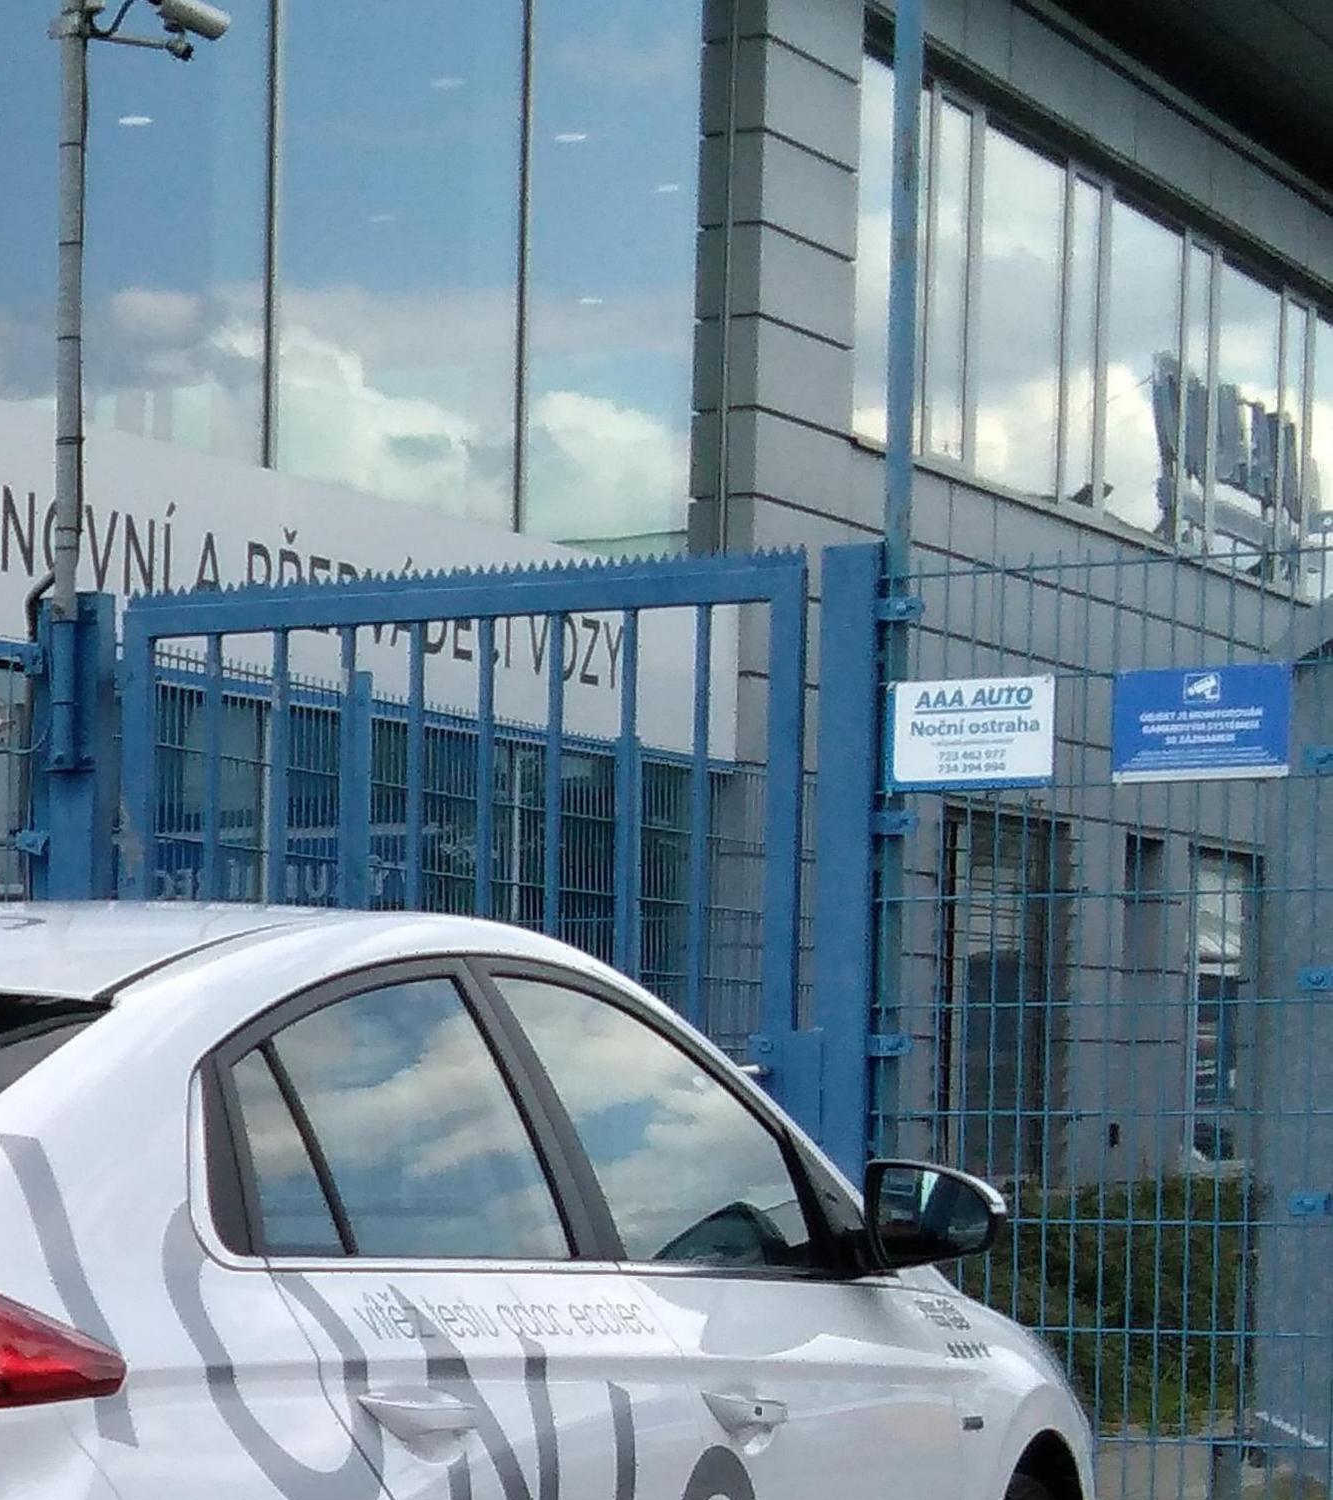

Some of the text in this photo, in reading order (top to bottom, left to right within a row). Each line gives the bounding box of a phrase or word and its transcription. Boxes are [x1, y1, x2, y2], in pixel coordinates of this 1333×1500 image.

[915, 686, 1034, 709] AAA AUTO
[910, 716, 1040, 737] Noční ostraha
